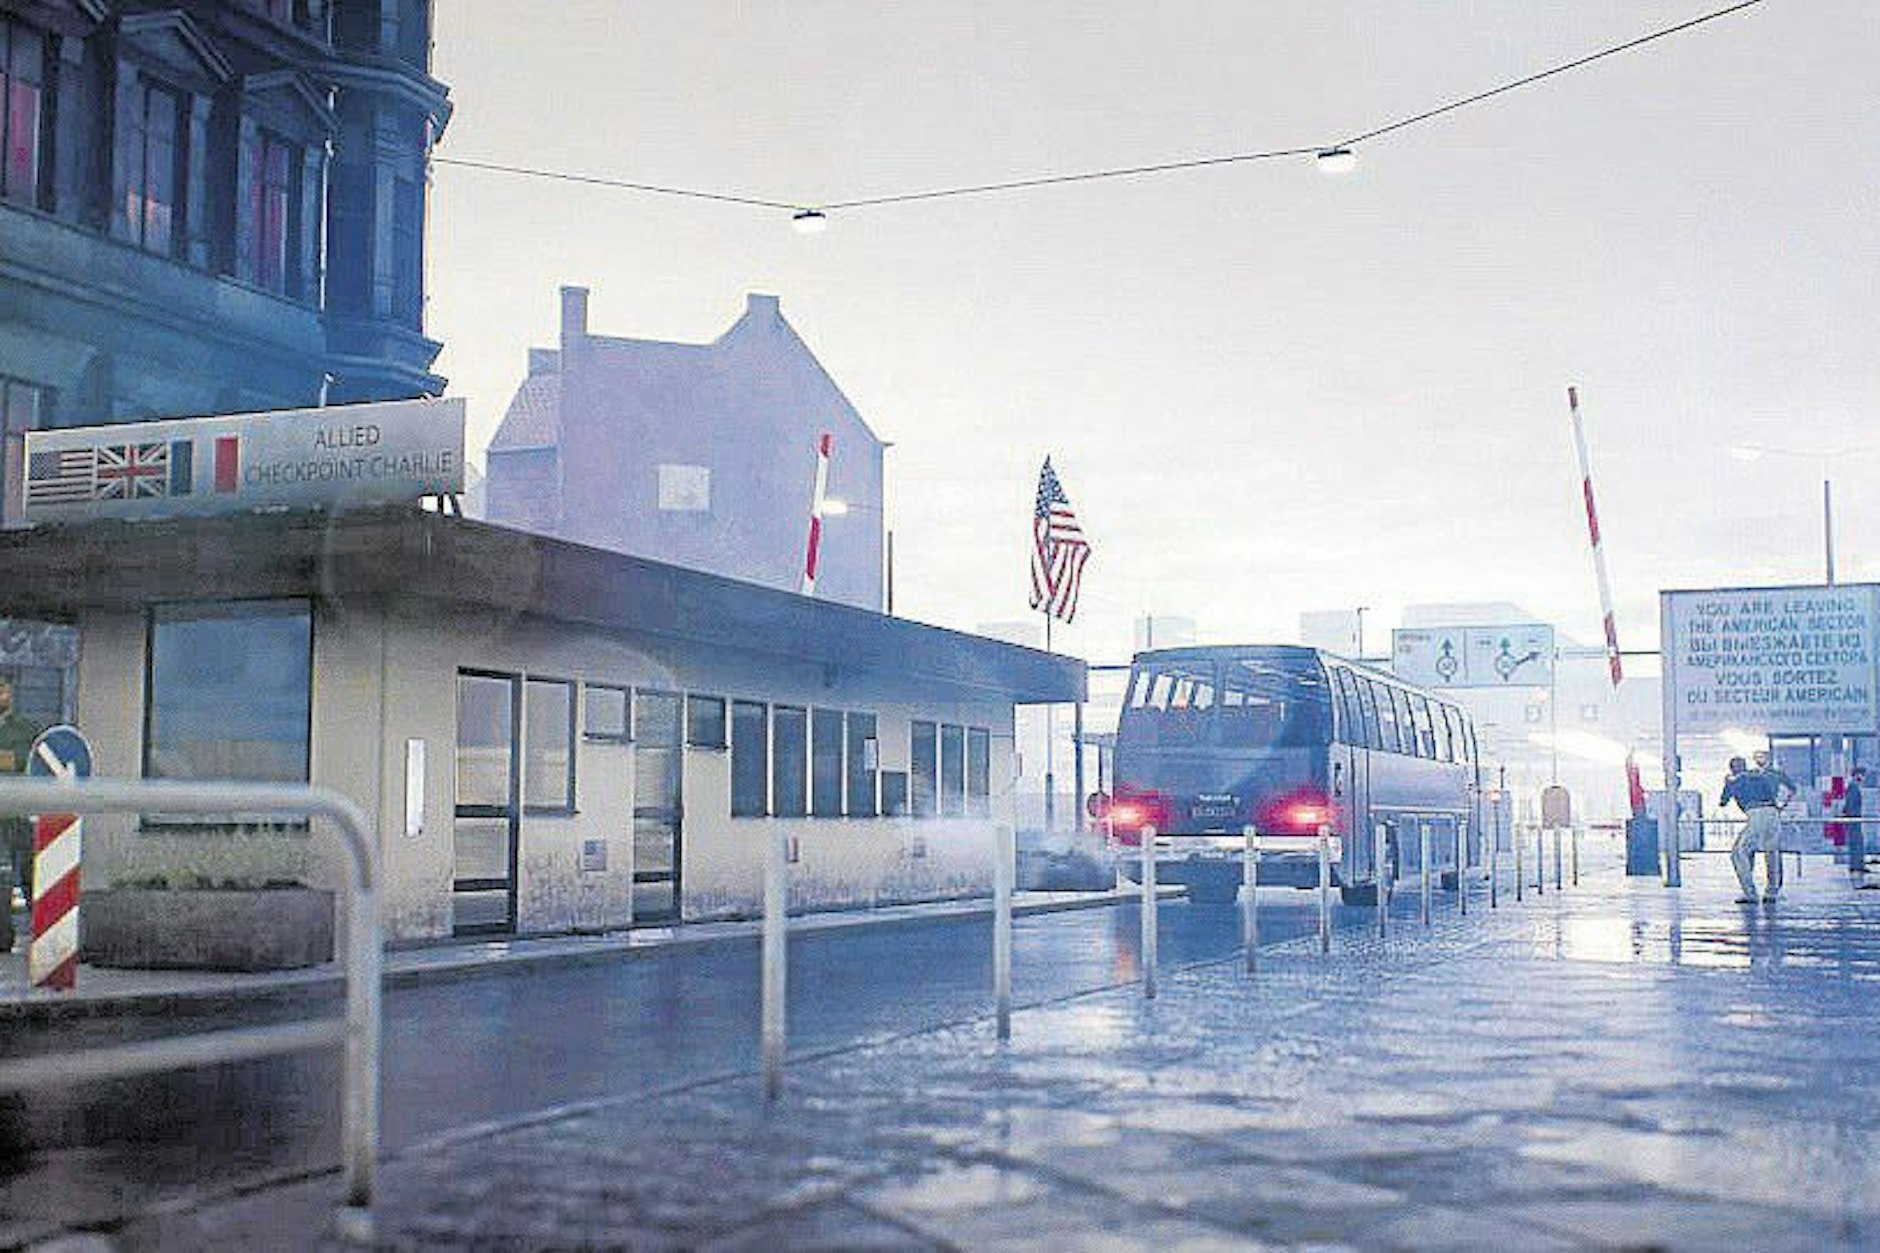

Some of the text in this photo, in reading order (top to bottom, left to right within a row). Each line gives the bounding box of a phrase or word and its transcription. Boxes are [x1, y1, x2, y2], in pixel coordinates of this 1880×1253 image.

[315, 425, 380, 449] ALLIED
[246, 450, 452, 484] CHECKPOINT CHARLIE
[1696, 598, 1856, 616] YOU ARE LEAVING
